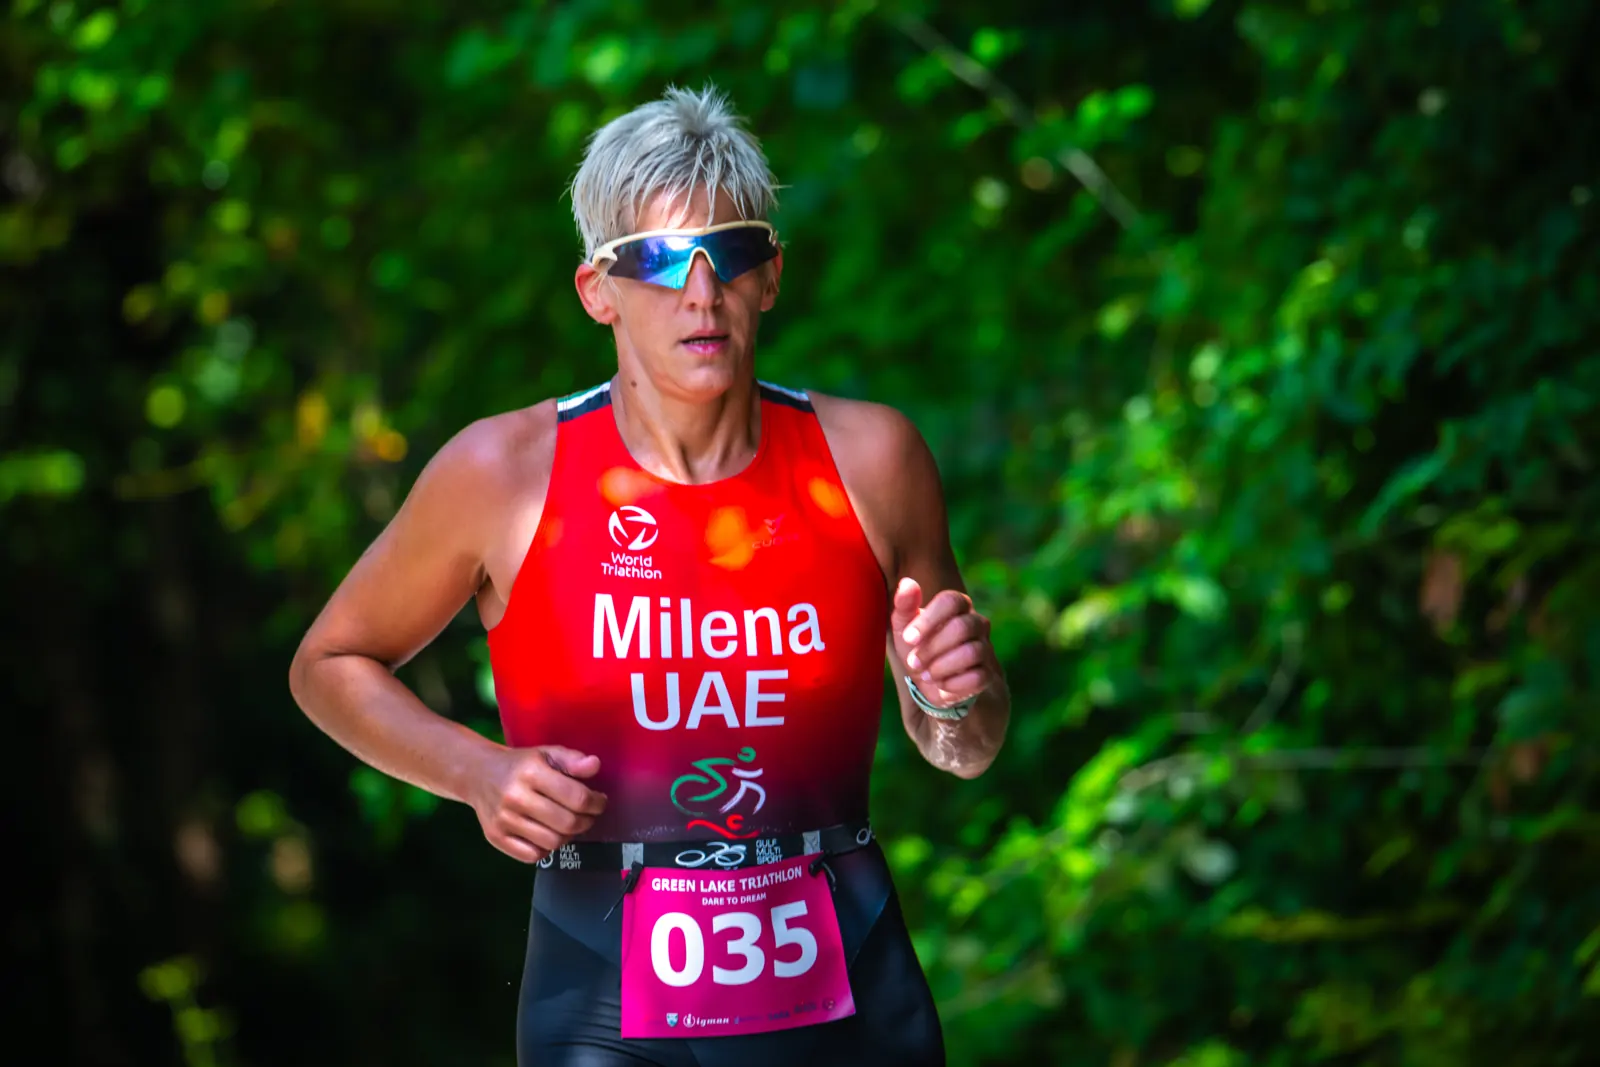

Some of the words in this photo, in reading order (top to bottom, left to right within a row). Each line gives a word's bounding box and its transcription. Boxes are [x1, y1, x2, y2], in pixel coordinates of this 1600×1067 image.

[611, 551, 652, 567] World
[601, 562, 662, 579] Triathlon
[593, 593, 825, 659] Milena
[630, 669, 789, 730] UAE
[756, 838, 777, 848] GULF
[560, 852, 580, 861] MULTI
[756, 846, 781, 856] MULTI
[560, 860, 582, 869] SPORT
[757, 854, 783, 865] SPORT
[651, 878, 696, 893] GREEN
[700, 880, 736, 893] LAKE
[739, 865, 803, 891] TRIATHLON
[702, 896, 725, 906] DARE
[726, 896, 739, 905] TO
[740, 892, 767, 905] DREAM
[650, 899, 818, 988] 035
